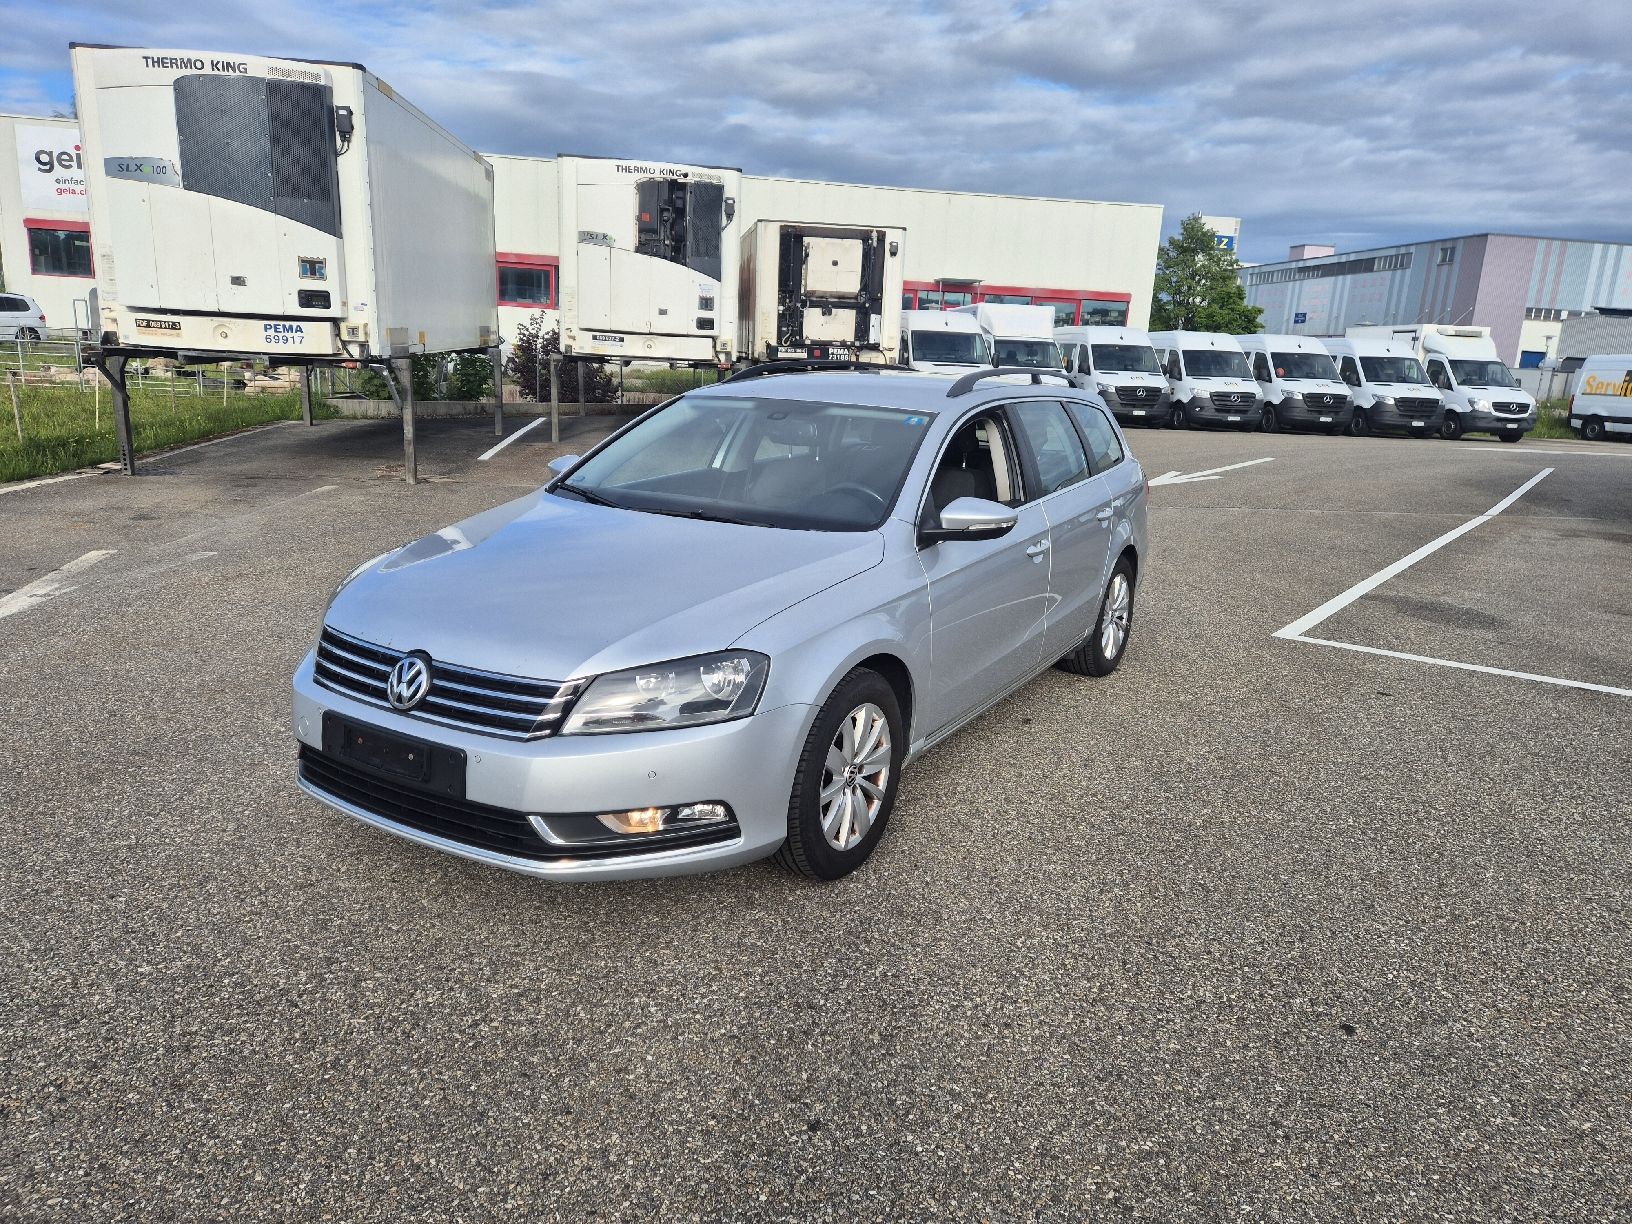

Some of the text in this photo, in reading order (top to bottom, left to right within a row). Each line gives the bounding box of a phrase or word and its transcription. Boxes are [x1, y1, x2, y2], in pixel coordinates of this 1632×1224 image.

[142, 55, 249, 74] THERMO KING
[117, 163, 144, 173] SLX
[615, 164, 683, 178] THERMO KING
[263, 323, 304, 334] PEMA
[265, 334, 304, 345] 69917
